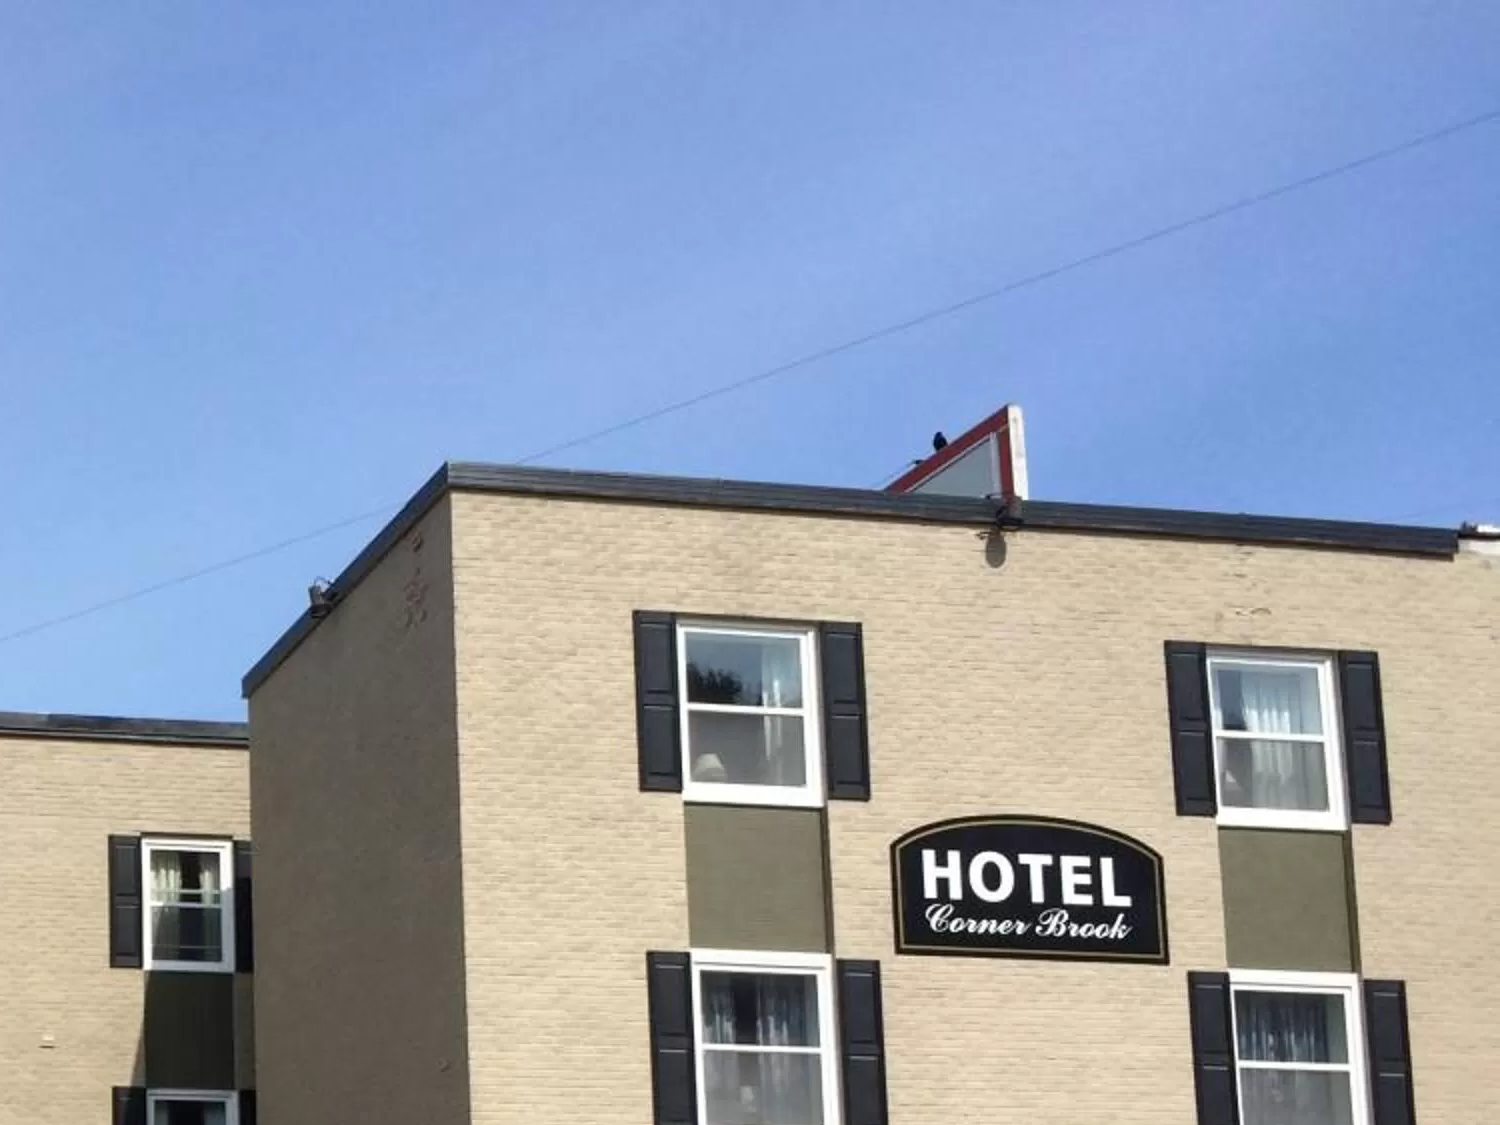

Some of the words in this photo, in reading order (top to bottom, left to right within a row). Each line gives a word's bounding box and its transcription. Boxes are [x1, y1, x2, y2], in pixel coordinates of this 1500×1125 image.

[921, 849, 1132, 907] HOTEL
[925, 903, 1030, 934] Corner
[1035, 909, 1132, 939] Brook
